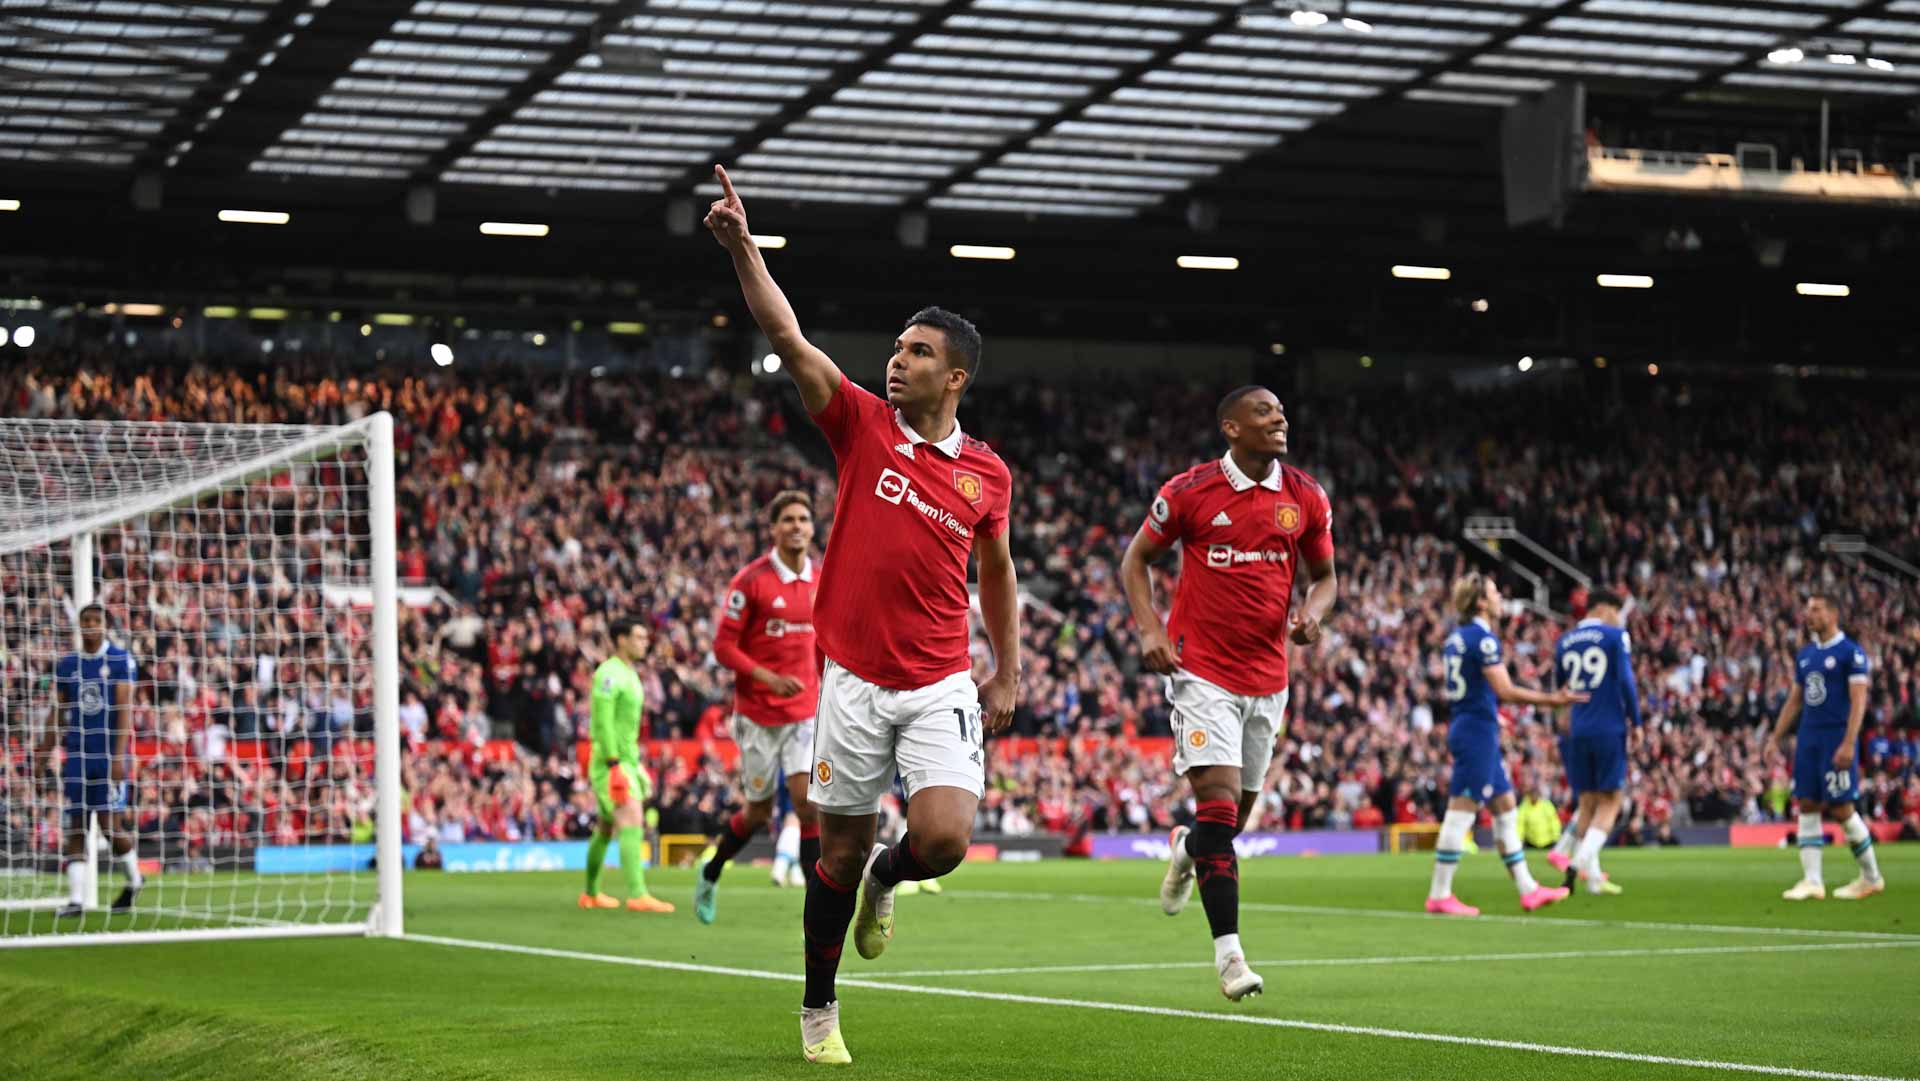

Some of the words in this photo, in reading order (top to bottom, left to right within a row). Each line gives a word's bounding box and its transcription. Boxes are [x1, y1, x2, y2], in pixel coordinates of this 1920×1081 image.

[1443, 655, 1467, 701] 3
[1562, 646, 1607, 690] 29
[1825, 769, 1851, 794] 20
